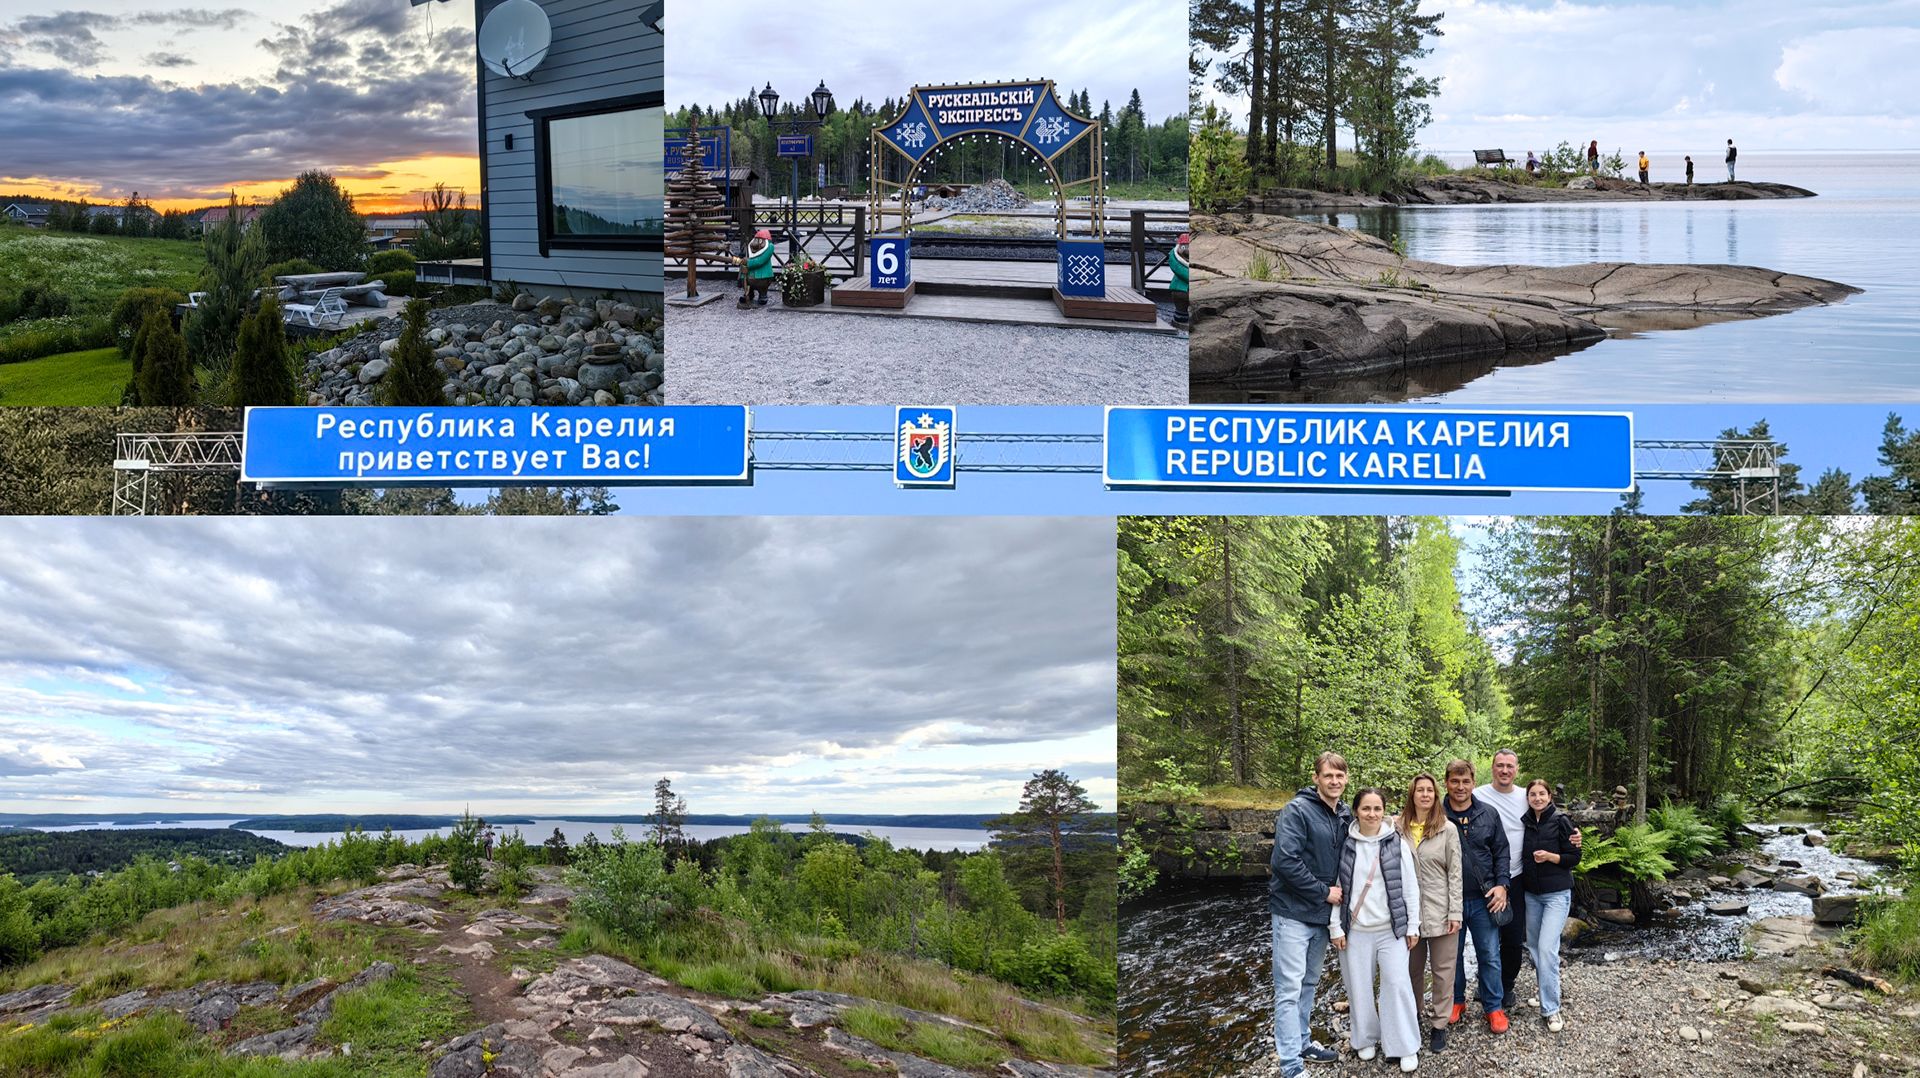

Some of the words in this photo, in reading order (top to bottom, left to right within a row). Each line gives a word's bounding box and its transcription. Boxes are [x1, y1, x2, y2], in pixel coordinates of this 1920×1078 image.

[928, 87, 1034, 108] РУСКЕАЛЬСКІЙ
[939, 107, 1023, 124] ЭКСПРЕССЪ
[877, 242, 899, 275] 6
[878, 276, 897, 285] лет
[316, 412, 515, 444] Республика
[531, 411, 675, 444] Карелия
[1166, 416, 1395, 445] РЕСПУБЛИКА
[1406, 420, 1570, 448] КАРЕЛИЯ
[338, 449, 567, 477] приветствует
[582, 443, 650, 469] Вас!
[1166, 449, 1328, 478] REPUBLIC
[1339, 451, 1487, 480] KARELIA
